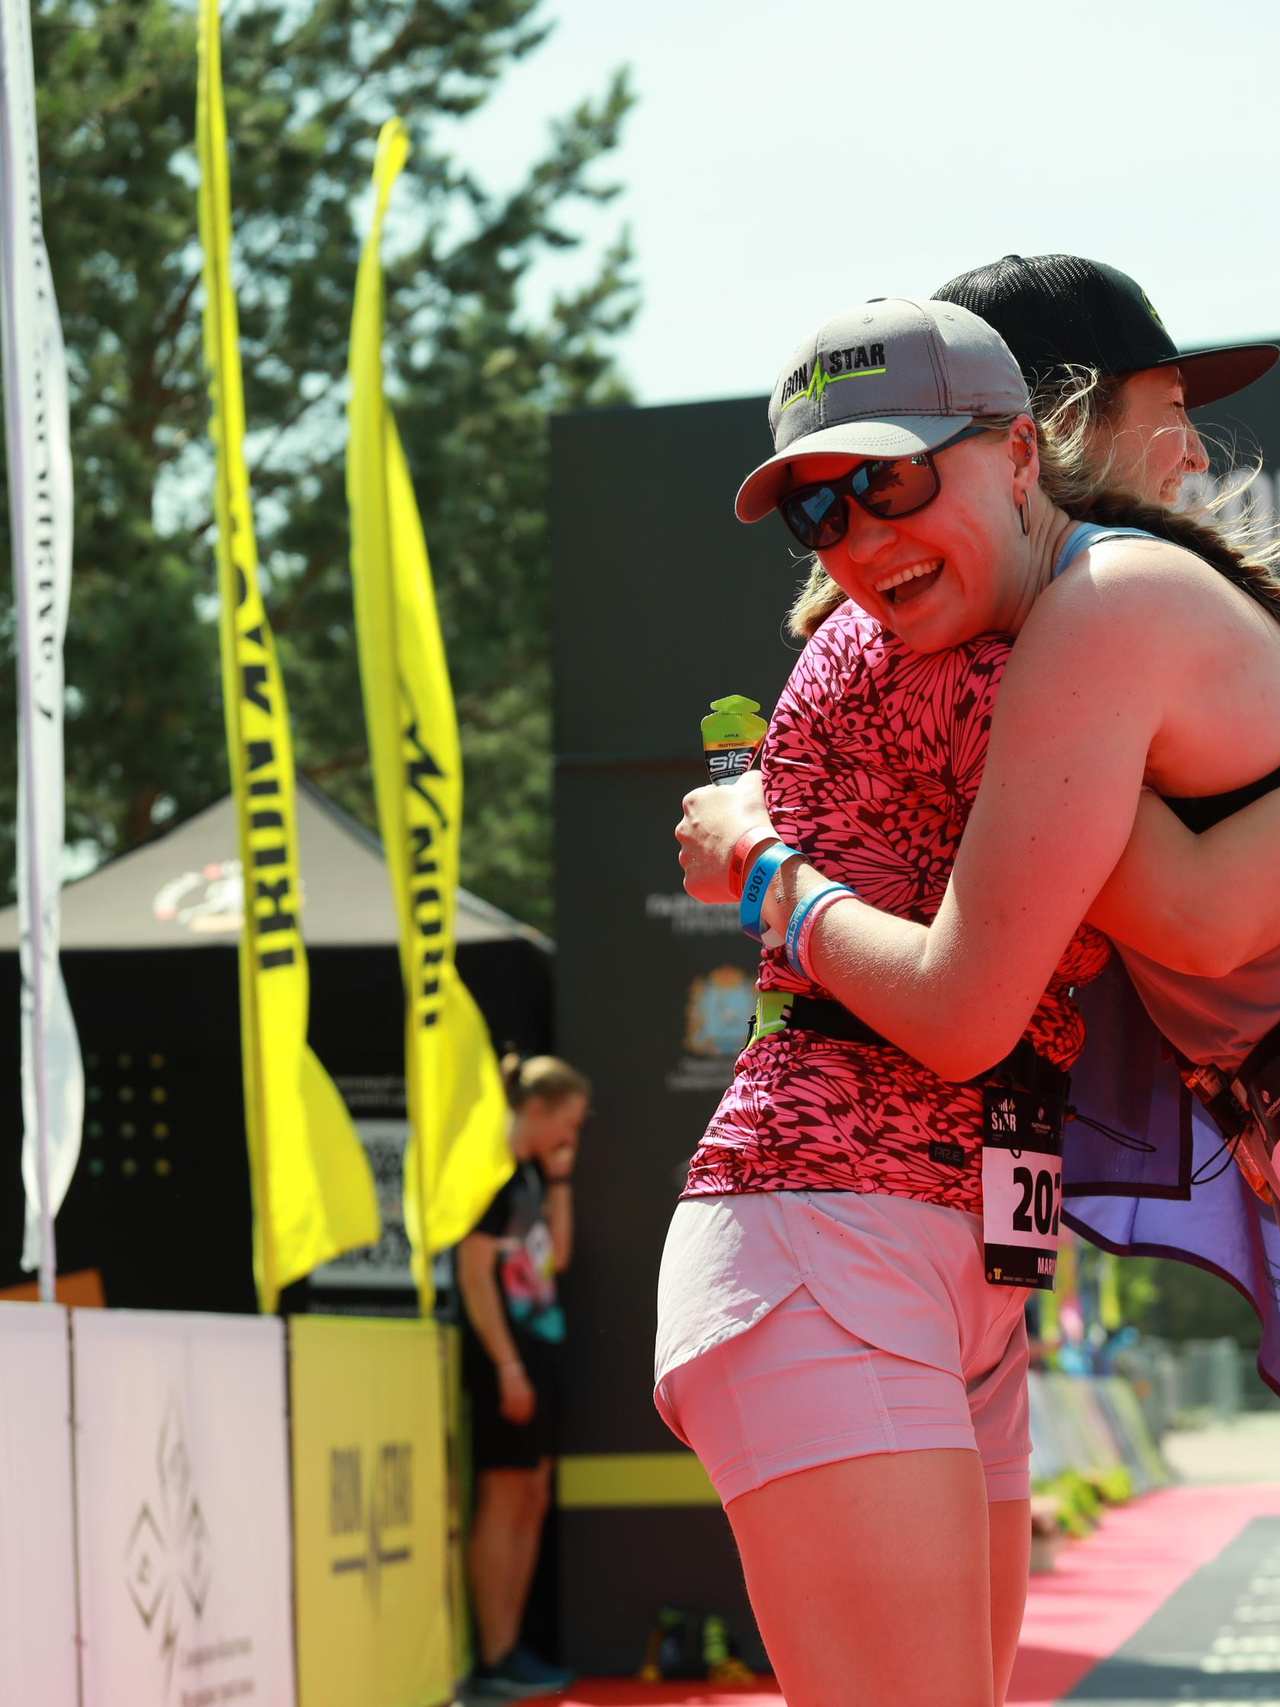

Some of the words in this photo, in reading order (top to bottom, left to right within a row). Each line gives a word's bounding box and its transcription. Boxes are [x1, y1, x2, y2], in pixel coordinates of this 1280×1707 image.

[781, 363, 808, 404] IRON
[829, 343, 885, 374] STAR
[746, 866, 767, 903] 0307
